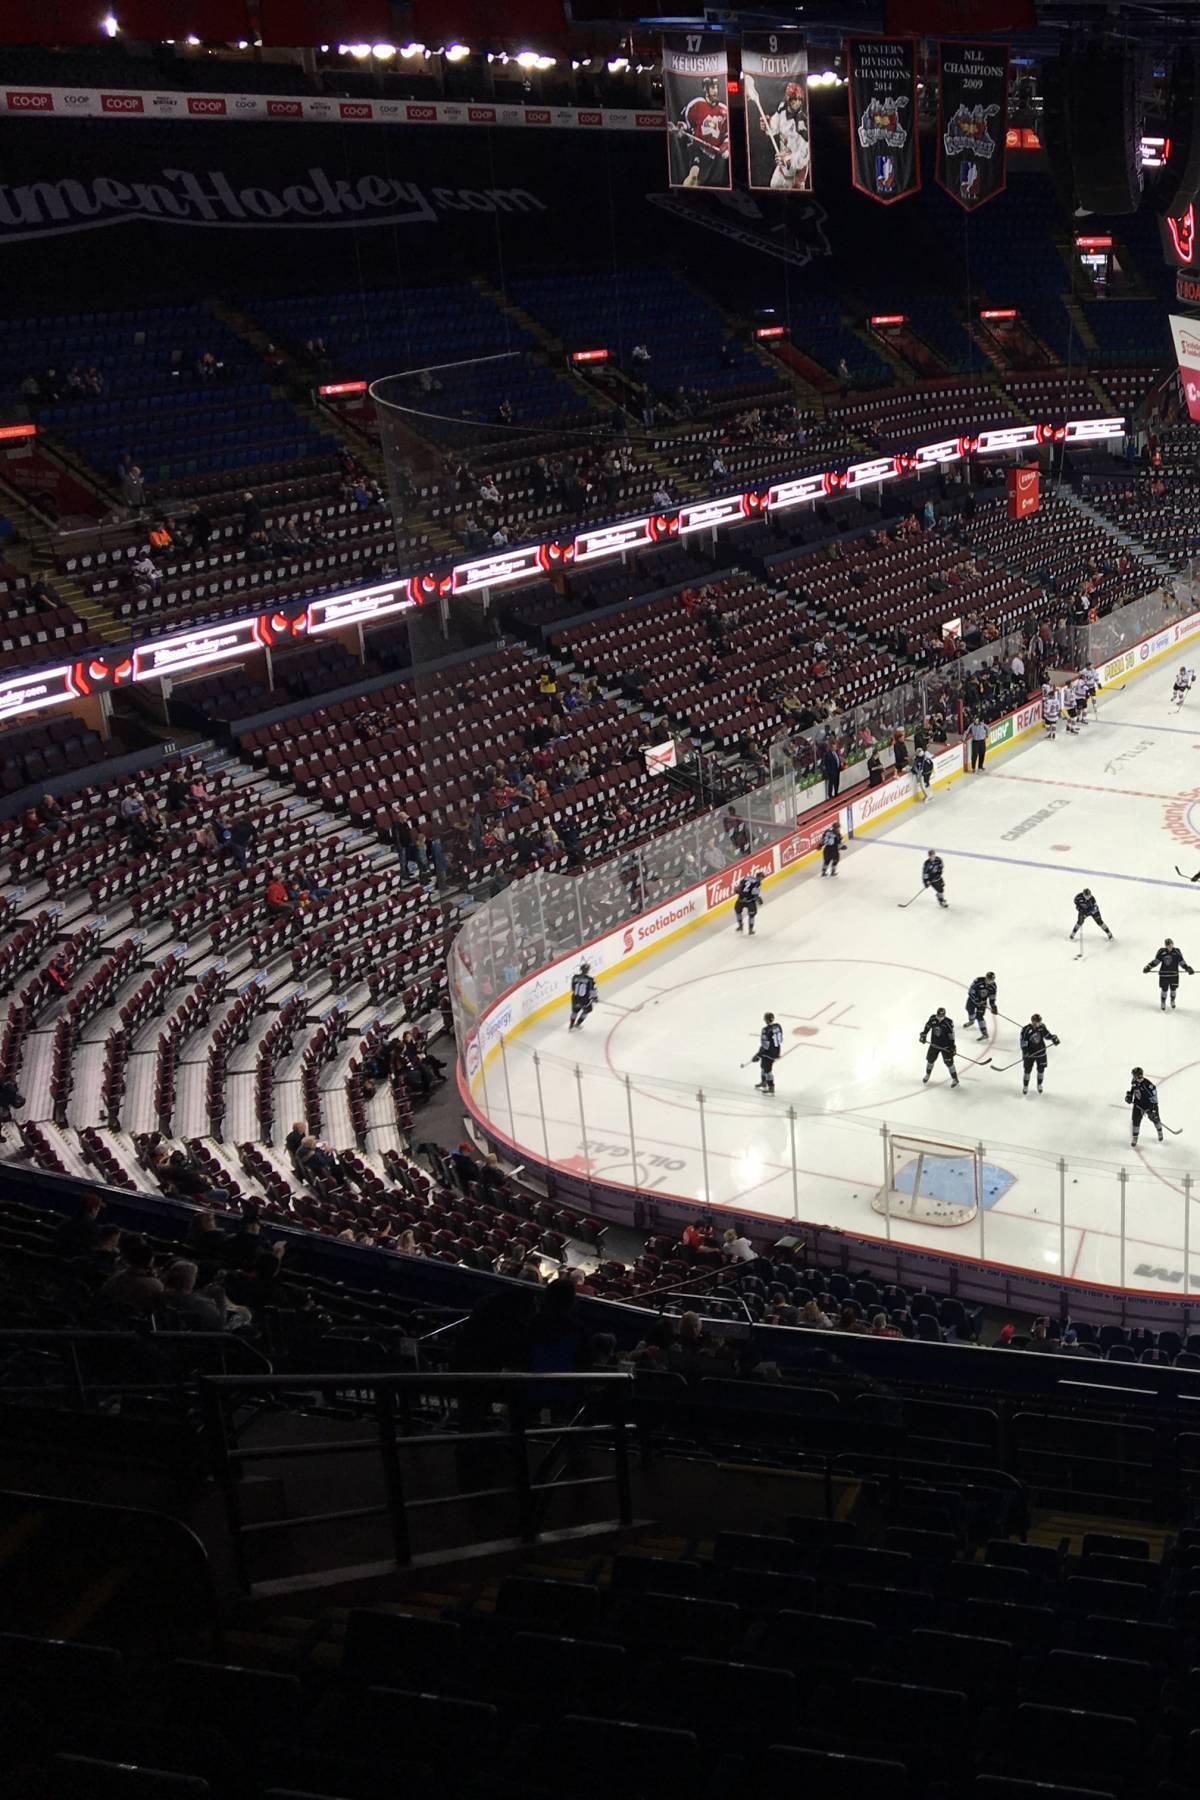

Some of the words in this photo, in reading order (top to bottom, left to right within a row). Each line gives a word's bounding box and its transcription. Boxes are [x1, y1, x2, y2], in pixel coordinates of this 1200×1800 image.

[686, 35, 702, 51] 17
[769, 35, 778, 52] 9
[858, 44, 904, 55] WESTERN
[672, 55, 719, 72] KELUSKY
[861, 56, 903, 66] DIVISION
[964, 51, 984, 61] NLL
[761, 57, 789, 73] TOTH
[944, 63, 1003, 77] CHAMPIONS
[854, 69, 911, 79] CHAMPIONS
[874, 82, 892, 91] 2014
[963, 79, 983, 89] 2009
[860, 782, 912, 821] Budweiser
[708, 879, 730, 910] Tim
[638, 901, 696, 941] Scotiabank
